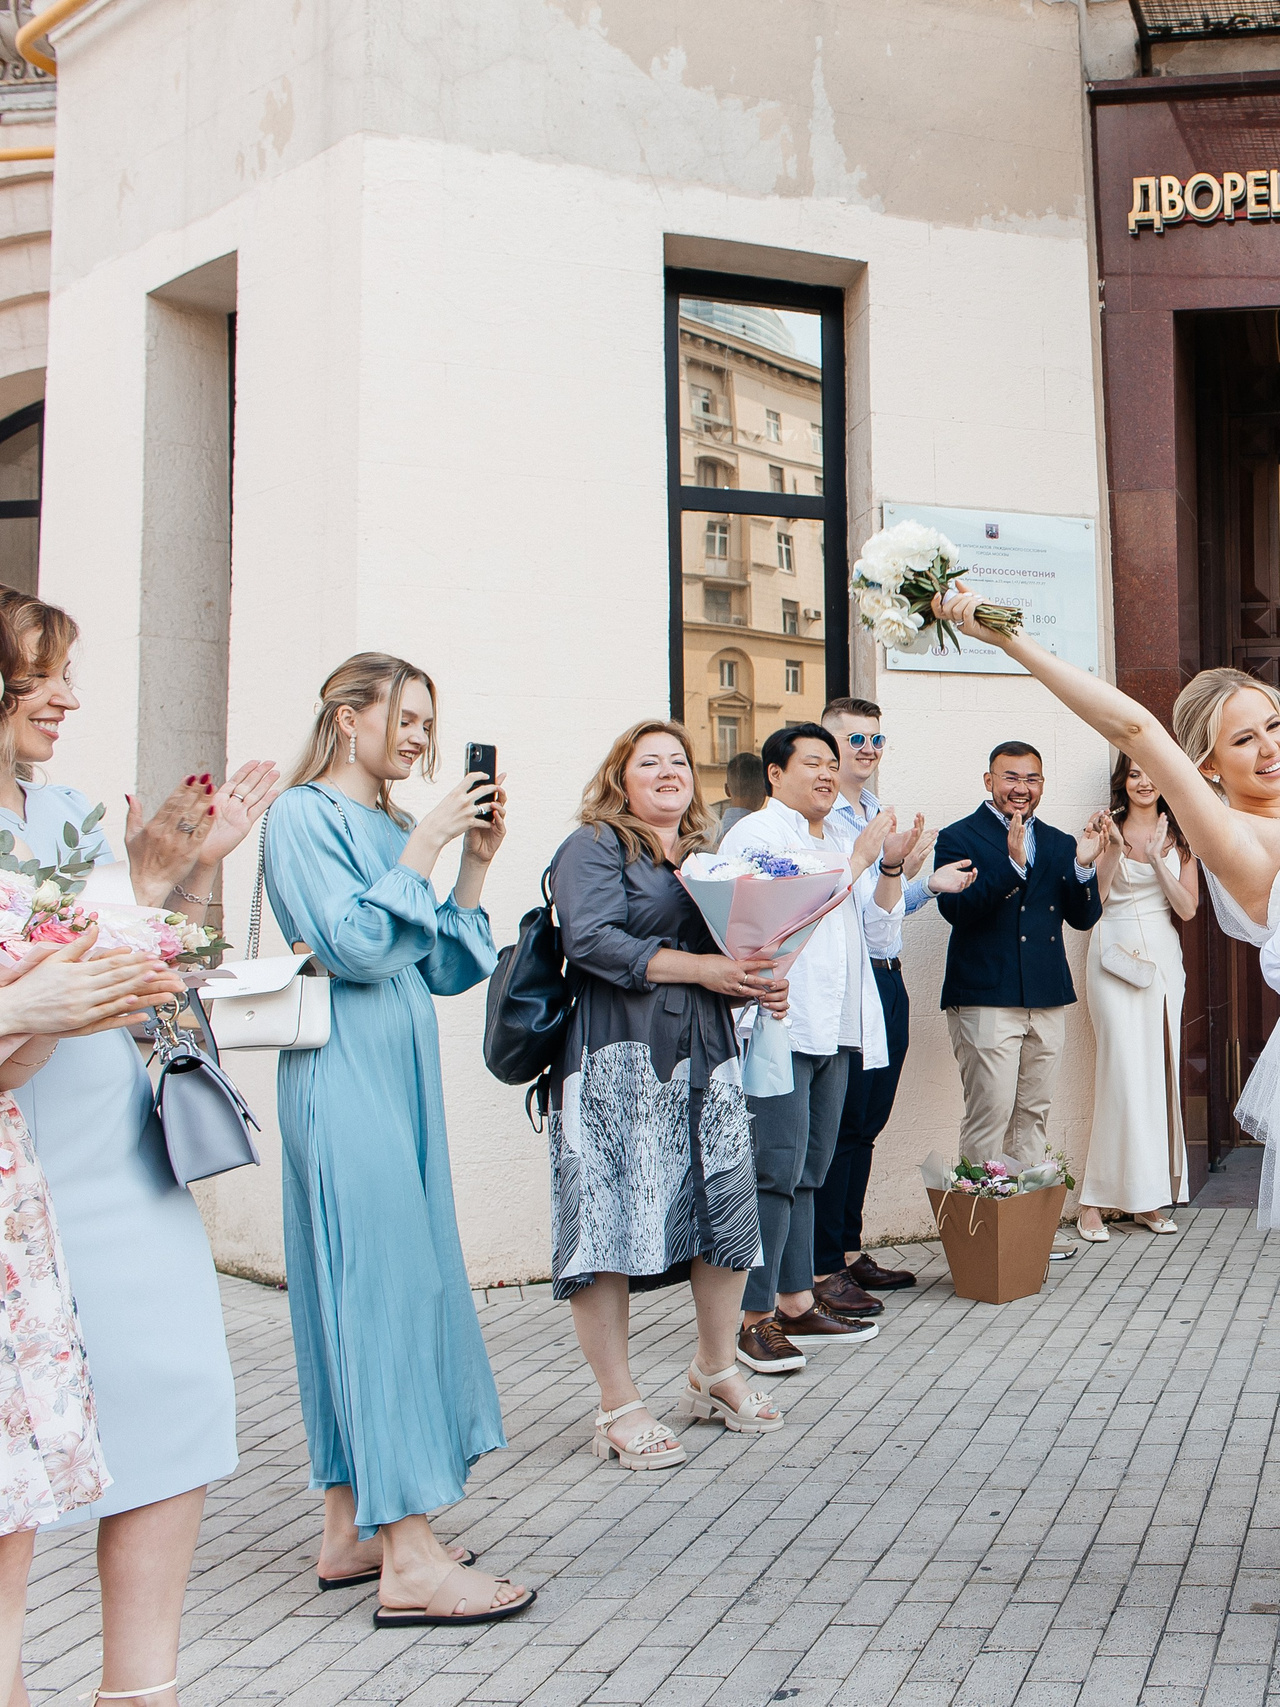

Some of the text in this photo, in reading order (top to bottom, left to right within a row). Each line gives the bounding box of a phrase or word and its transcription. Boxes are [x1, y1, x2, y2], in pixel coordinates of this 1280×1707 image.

[972, 563, 1056, 578] бракосочетания
[994, 597, 1033, 607] РАБОТЫ
[1032, 614, 1056, 624] 18:00
